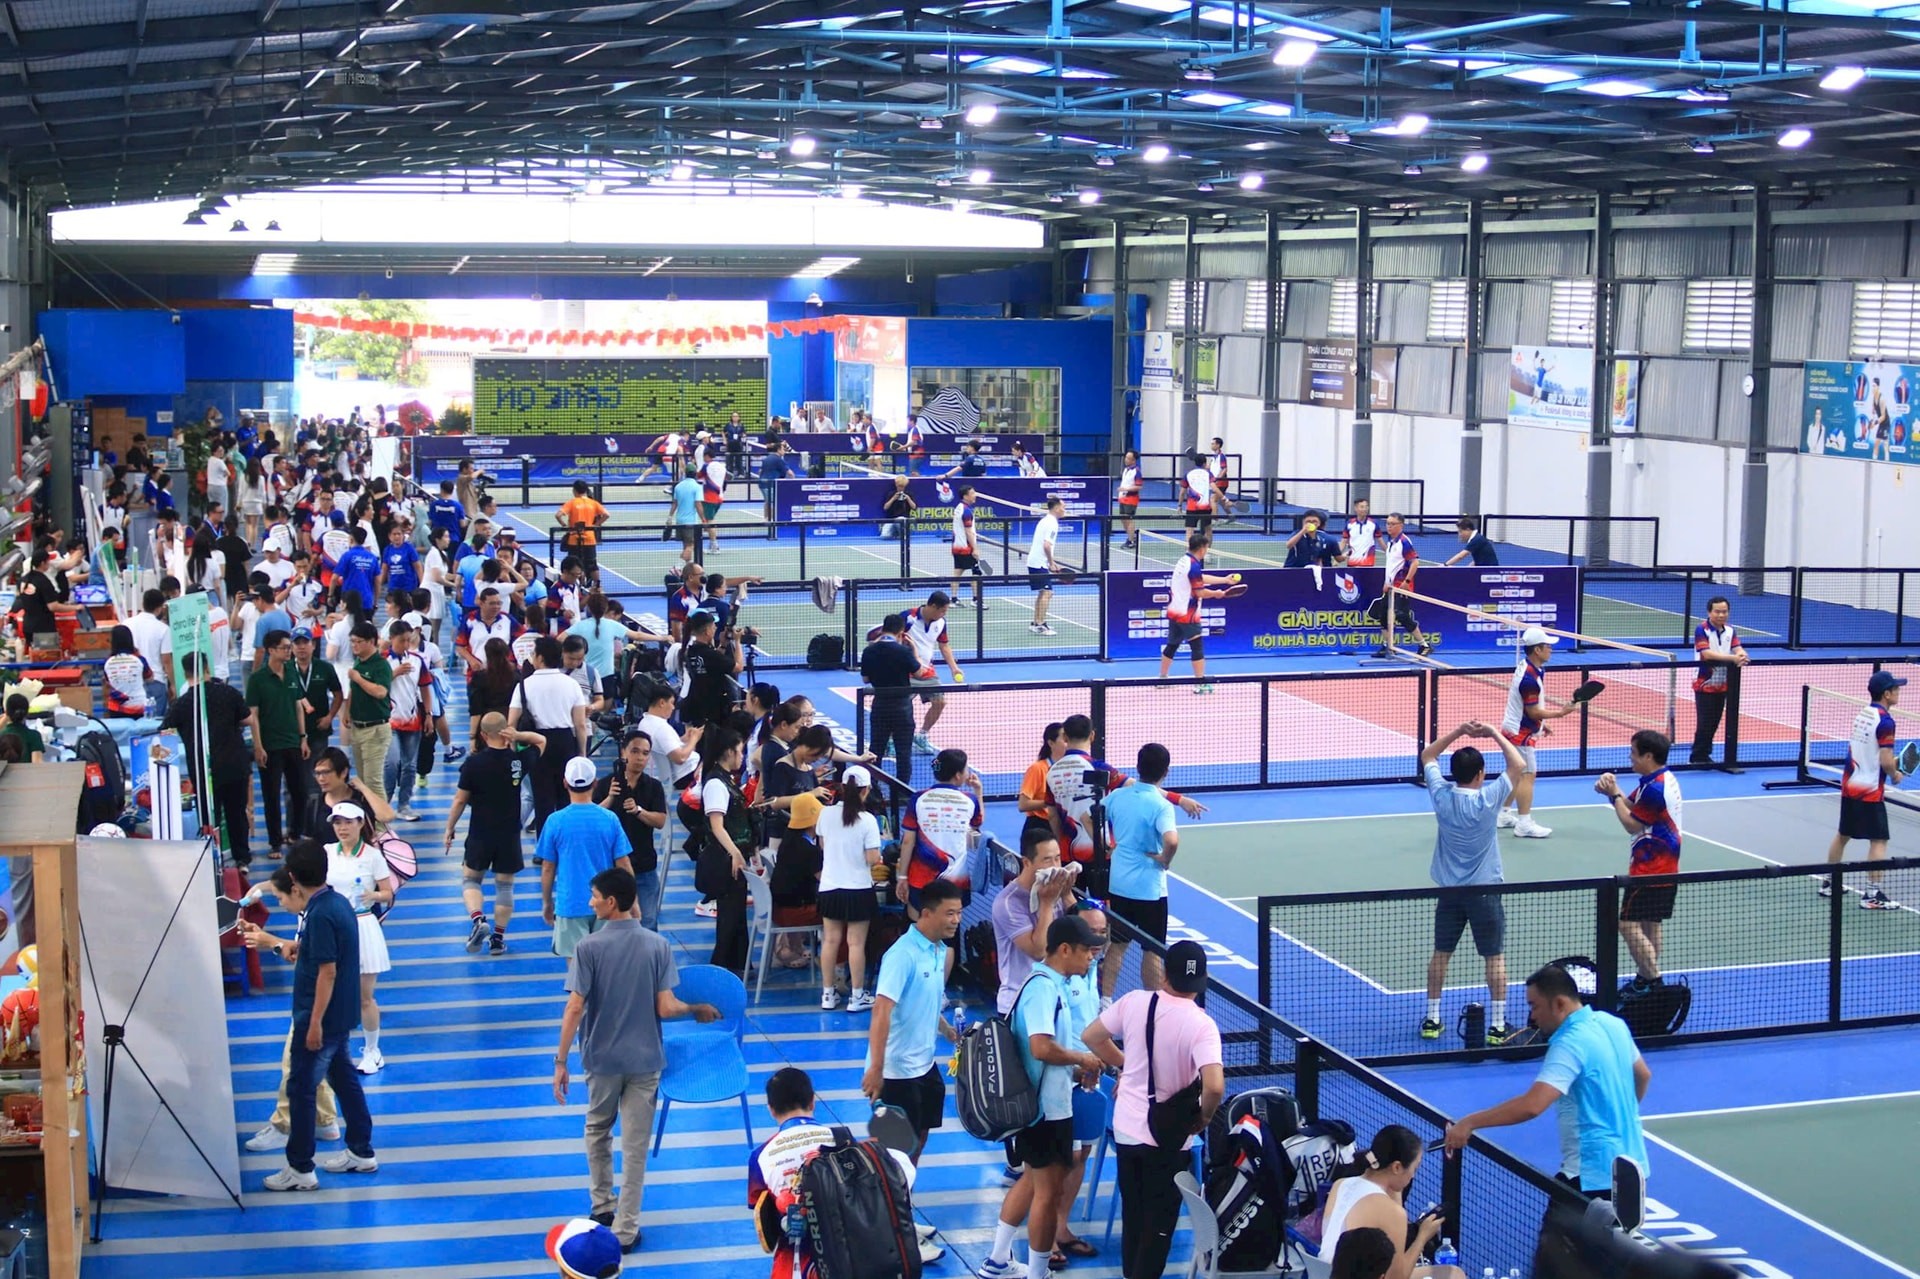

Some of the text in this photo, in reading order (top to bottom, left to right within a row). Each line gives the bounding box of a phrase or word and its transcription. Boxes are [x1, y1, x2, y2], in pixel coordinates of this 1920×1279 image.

[1337, 347, 1353, 357] AUTO
[1278, 607, 1313, 628] GIẢI
[1253, 633, 1276, 649] HỘI
[1278, 632, 1306, 647] NHÀ
[1307, 631, 1337, 646] BÁO
[1338, 631, 1367, 647] VIỆT
[983, 1027, 996, 1094] FACOLOS
